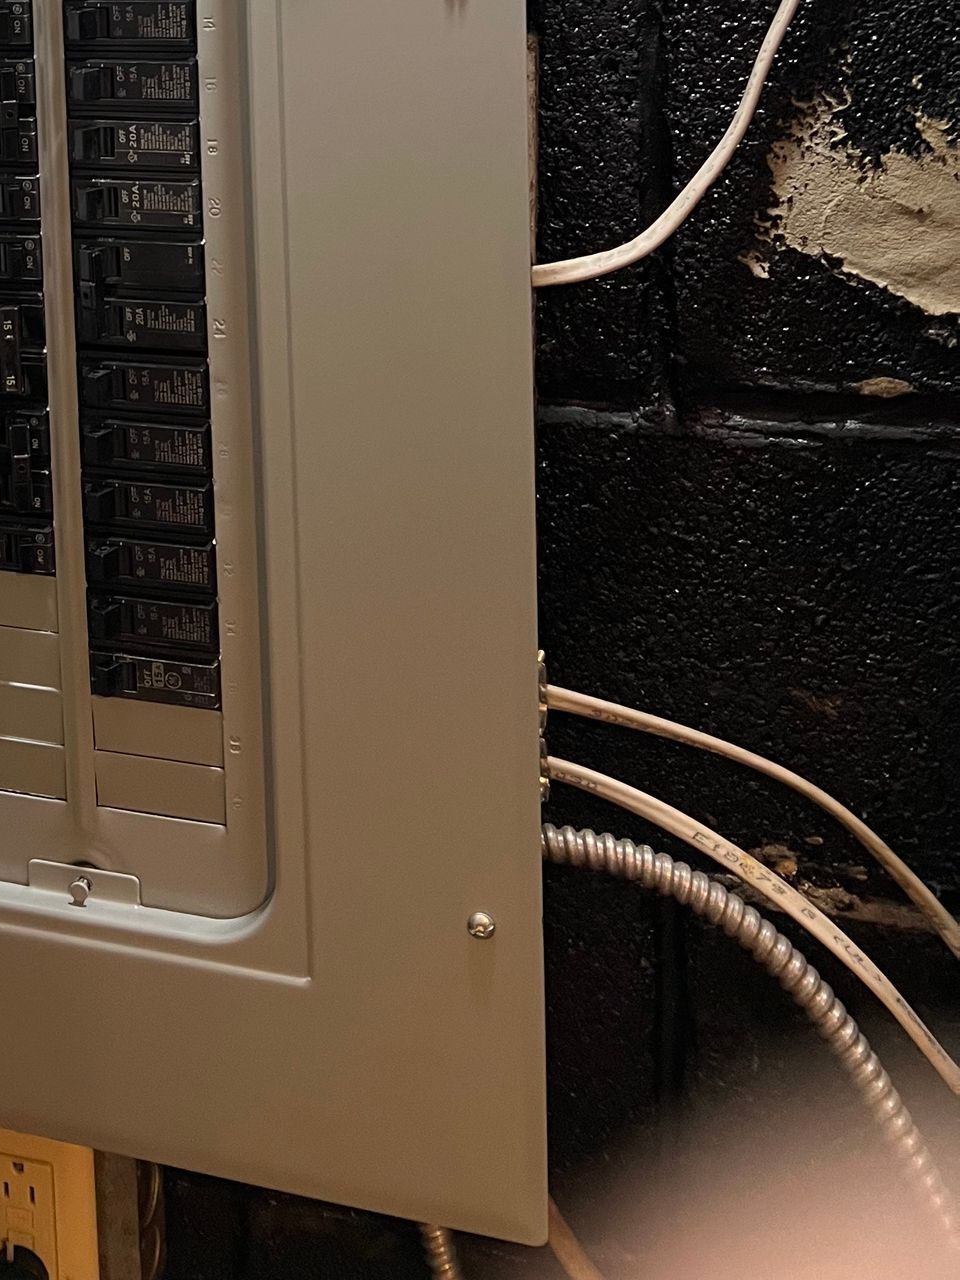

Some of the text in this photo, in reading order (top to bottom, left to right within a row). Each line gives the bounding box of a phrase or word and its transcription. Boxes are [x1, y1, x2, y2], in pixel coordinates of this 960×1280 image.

[14, 20, 21, 33] ON
[18, 80, 25, 94] ON
[129, 125, 137, 148] 20A
[22, 138, 28, 152] ON
[24, 197, 31, 210] ON
[209, 198, 221, 218] 20
[26, 256, 33, 269] ON
[3, 320, 12, 330] 15
[6, 375, 15, 386] 15
[32, 438, 38, 449] ON
[34, 497, 41, 508] ON
[37, 549, 44, 563] ON
